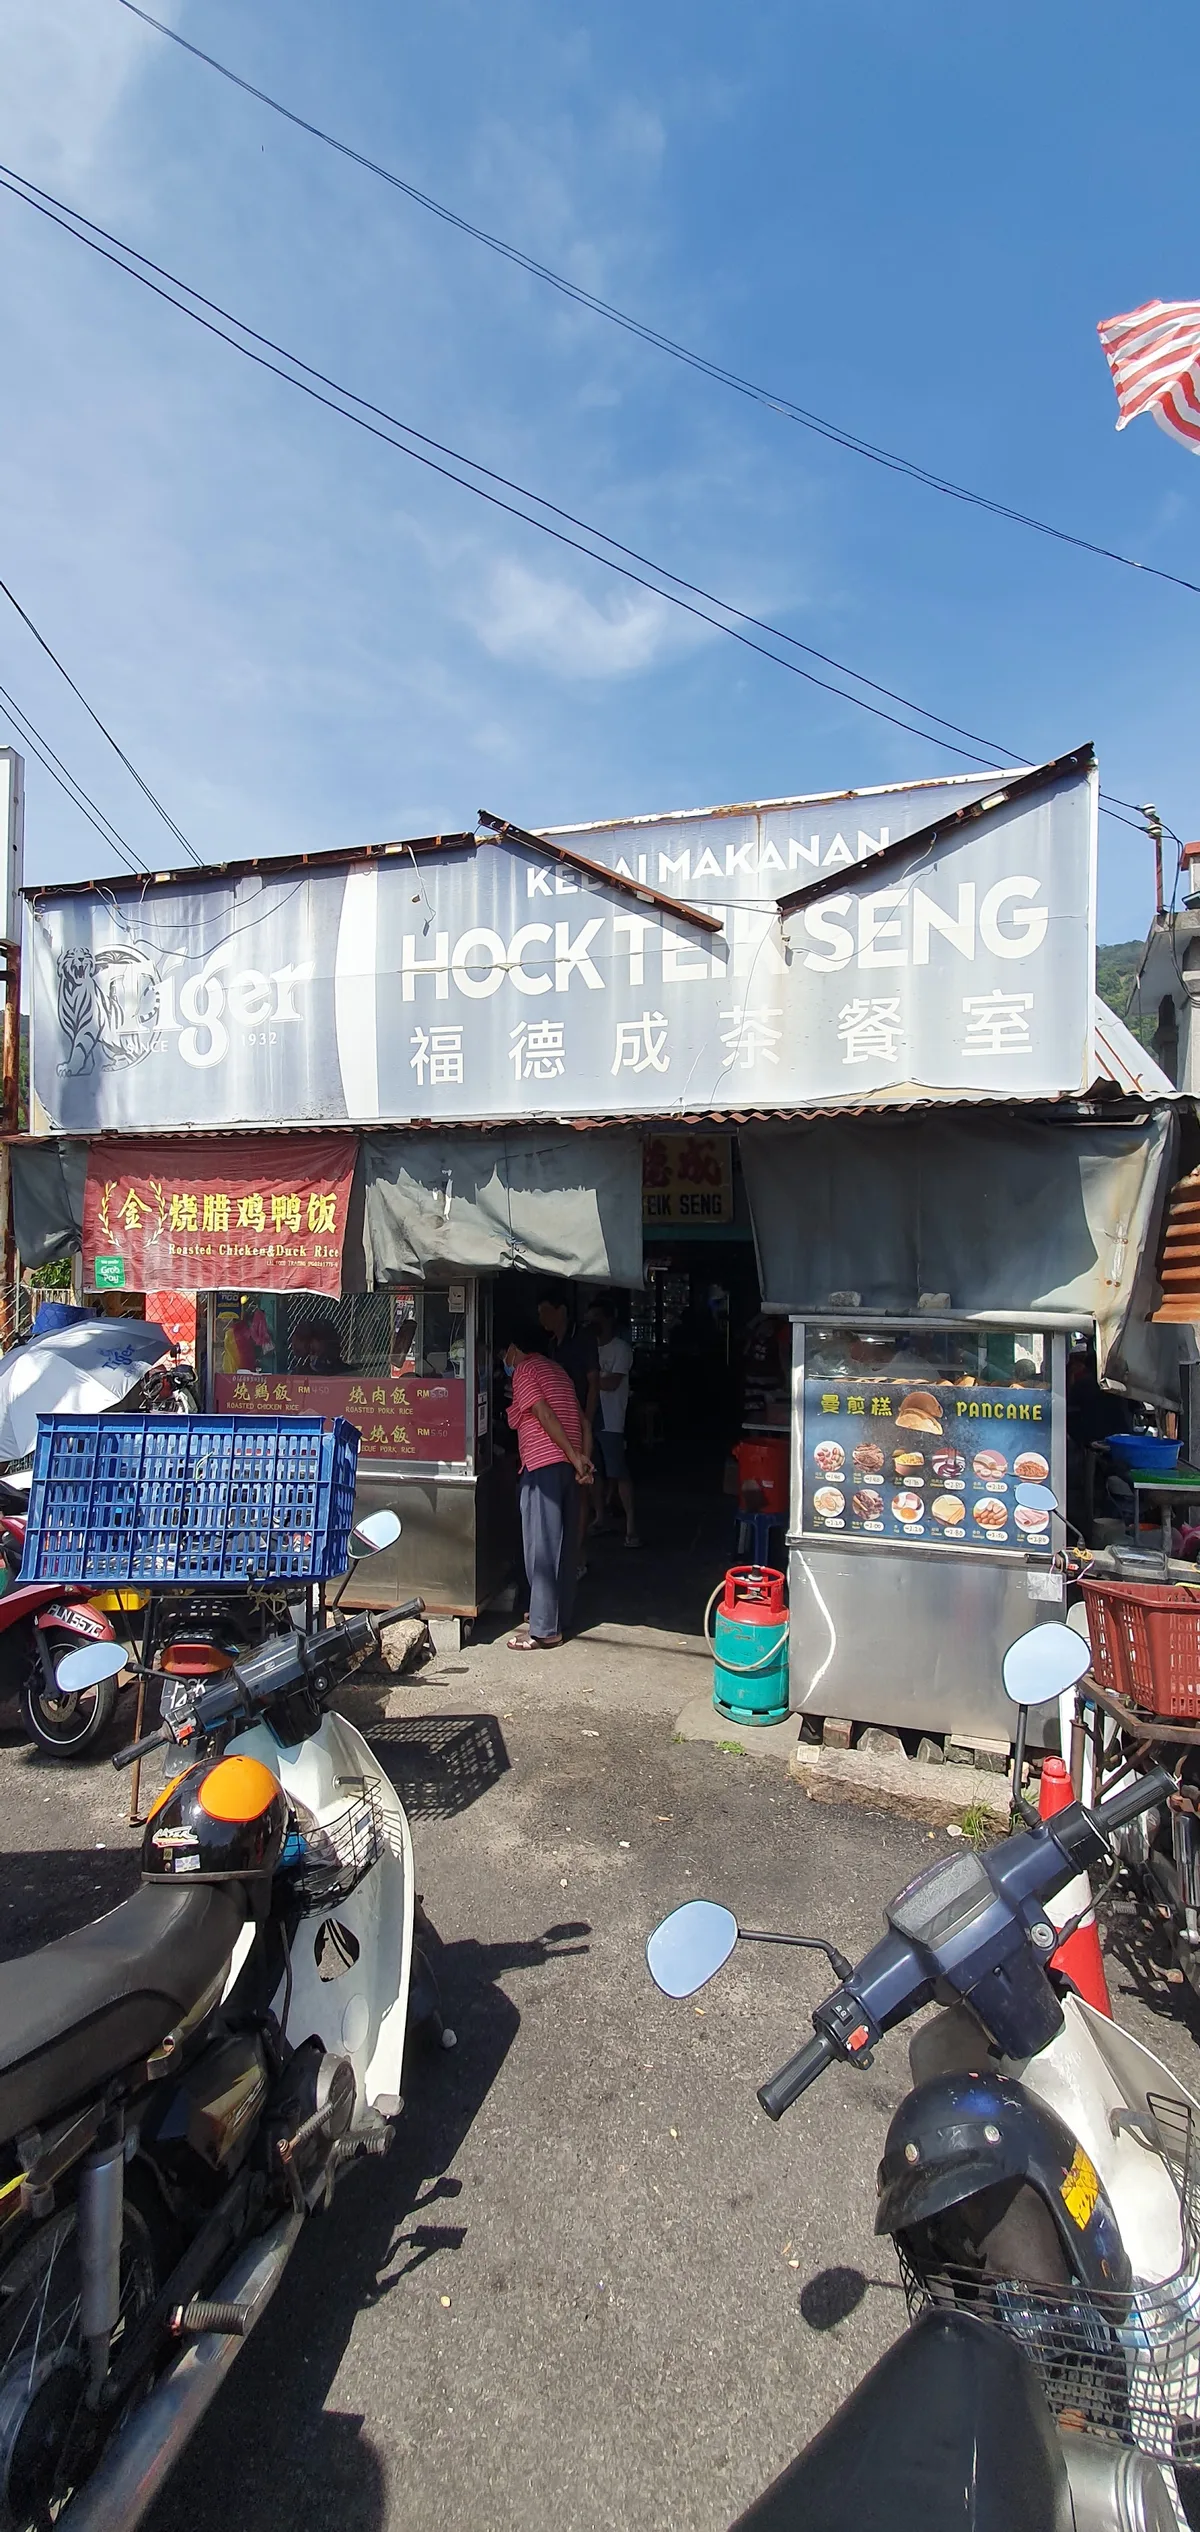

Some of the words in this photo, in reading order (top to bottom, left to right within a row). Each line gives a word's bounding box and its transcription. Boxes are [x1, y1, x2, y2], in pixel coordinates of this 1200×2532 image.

[657, 826, 890, 884] MAKANAN
[402, 916, 606, 1002] HOCK
[613, 902, 790, 986] TEIK
[803, 875, 1049, 973] SENG
[96, 940, 317, 1070] Tiger
[126, 1039, 169, 1053] SINCE
[241, 1031, 278, 1047] 1932
[409, 988, 1034, 1086] 福德成茶餐室
[117, 1187, 153, 1230] 金
[169, 1192, 338, 1234] 烧腊鸡鸭饭
[679, 1194, 722, 1215] SENG
[168, 1243, 212, 1256] Roasted
[313, 1245, 339, 1258] Rice
[101, 1265, 120, 1274] Grab
[103, 1273, 119, 1284] Pay
[101, 1343, 135, 1371] Tiger
[226, 1402, 255, 1410] ROASTED
[257, 1402, 282, 1411] CHICKEN
[285, 1403, 299, 1411] RICE
[345, 1406, 375, 1414] ROASTED
[378, 1407, 395, 1415] PORK
[820, 1394, 893, 1416] 曼煎糕
[955, 1400, 1043, 1422] PANCAKE
[380, 1445, 397, 1454] PORK
[401, 1446, 416, 1454] RICE
[47, 1603, 73, 1623] PLN
